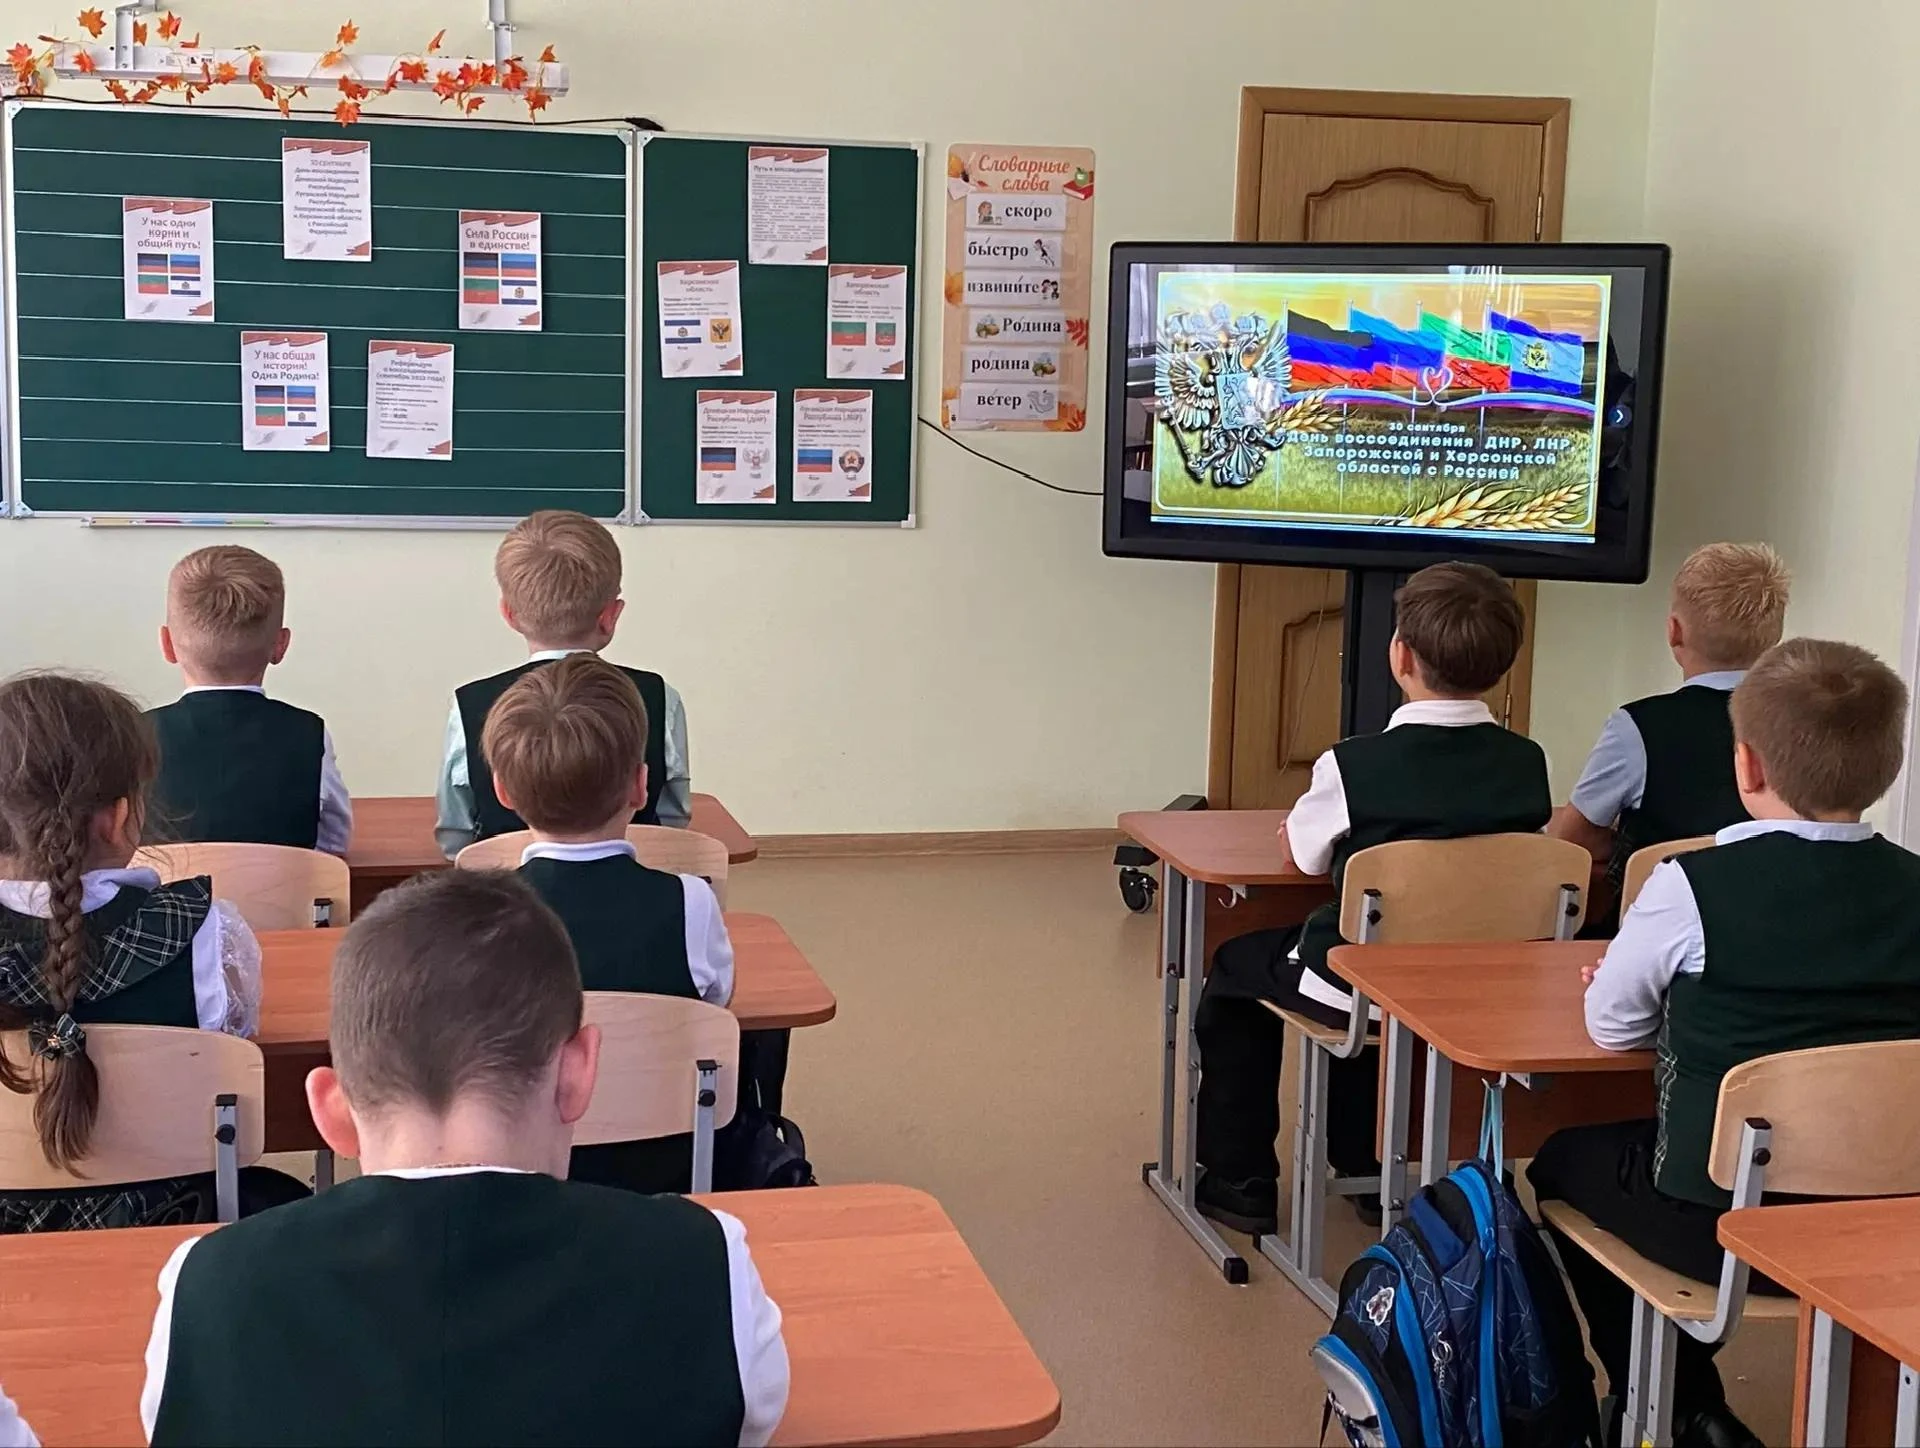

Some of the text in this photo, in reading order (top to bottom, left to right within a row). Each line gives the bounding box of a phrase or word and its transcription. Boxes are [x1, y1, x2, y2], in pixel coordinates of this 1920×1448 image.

[978, 154, 1071, 178] Словарные
[1002, 173, 1050, 192] слова
[141, 217, 196, 228] У нас одни
[148, 229, 190, 240] корни и
[465, 228, 490, 239] Сила
[492, 229, 530, 240] России
[137, 239, 201, 251] общий путь!
[478, 241, 530, 251] единстве!
[254, 350, 316, 362] У нас общая
[263, 362, 308, 371] история!
[251, 371, 320, 381] Одна Родина!
[1388, 421, 1466, 434] 30 сентября
[1286, 430, 1576, 452] День воссоединения ДНР, ЛНР,
[1304, 445, 1557, 465] Запорожской и Херсонской
[1336, 460, 1520, 480] областей с Россией
